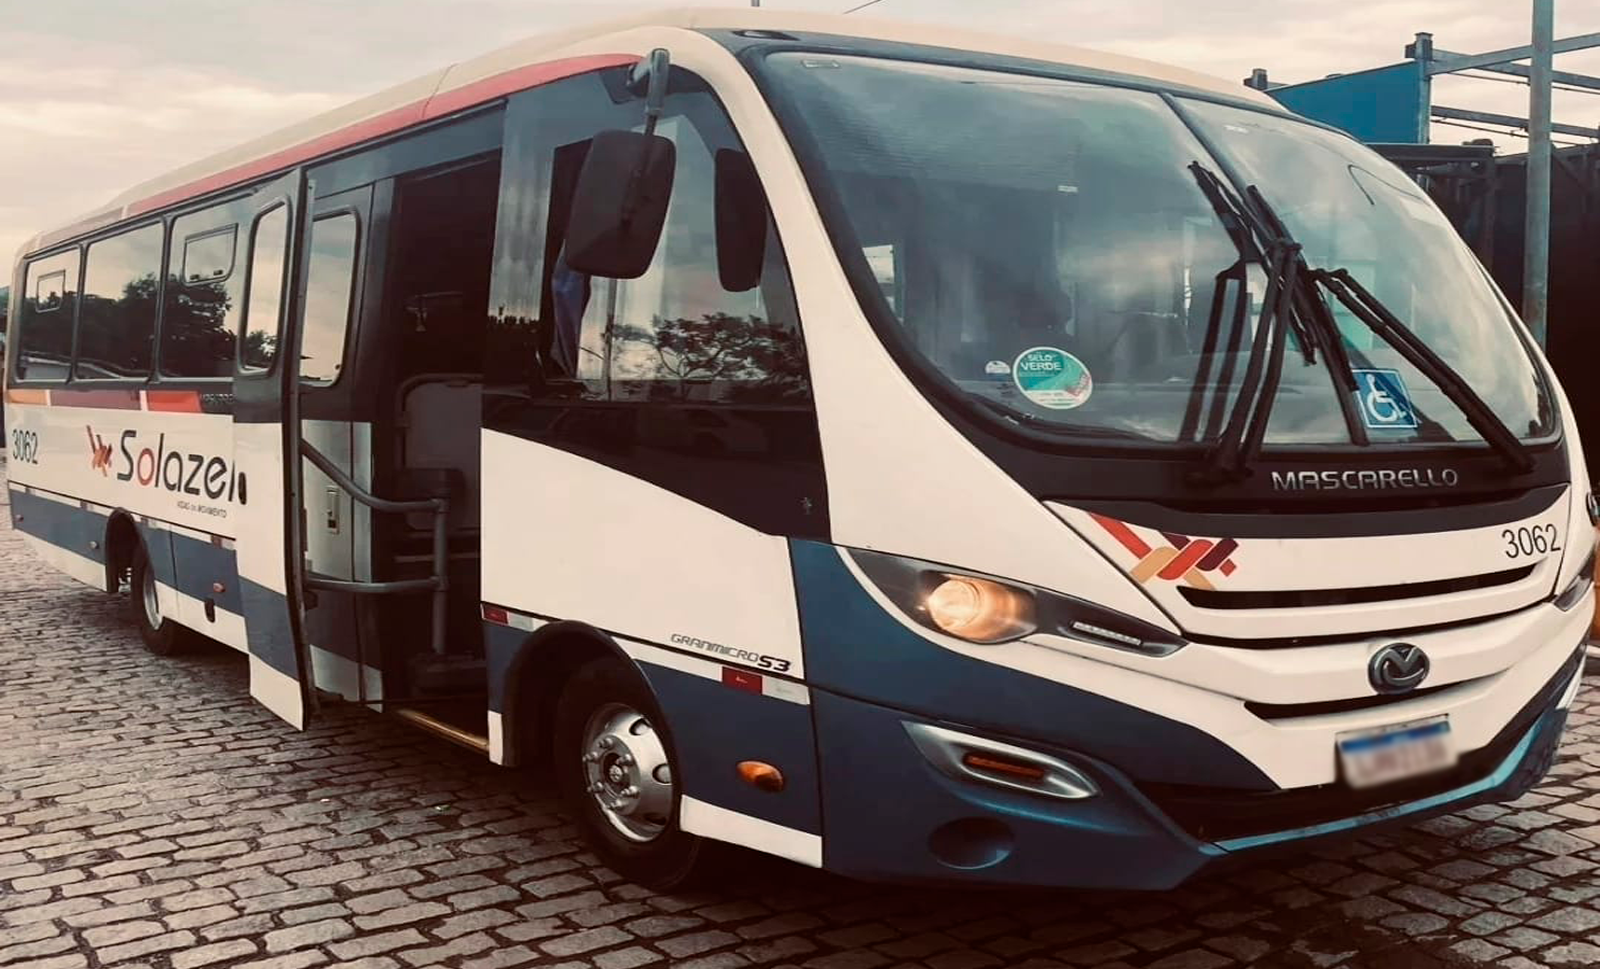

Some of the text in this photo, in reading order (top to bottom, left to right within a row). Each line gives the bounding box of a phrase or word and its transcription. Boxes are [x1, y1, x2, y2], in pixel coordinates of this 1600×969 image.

[1020, 361, 1062, 370] VERDE
[12, 428, 38, 465] 3062
[1271, 468, 1458, 490] MASCARELLO
[1502, 523, 1561, 559] 3062
